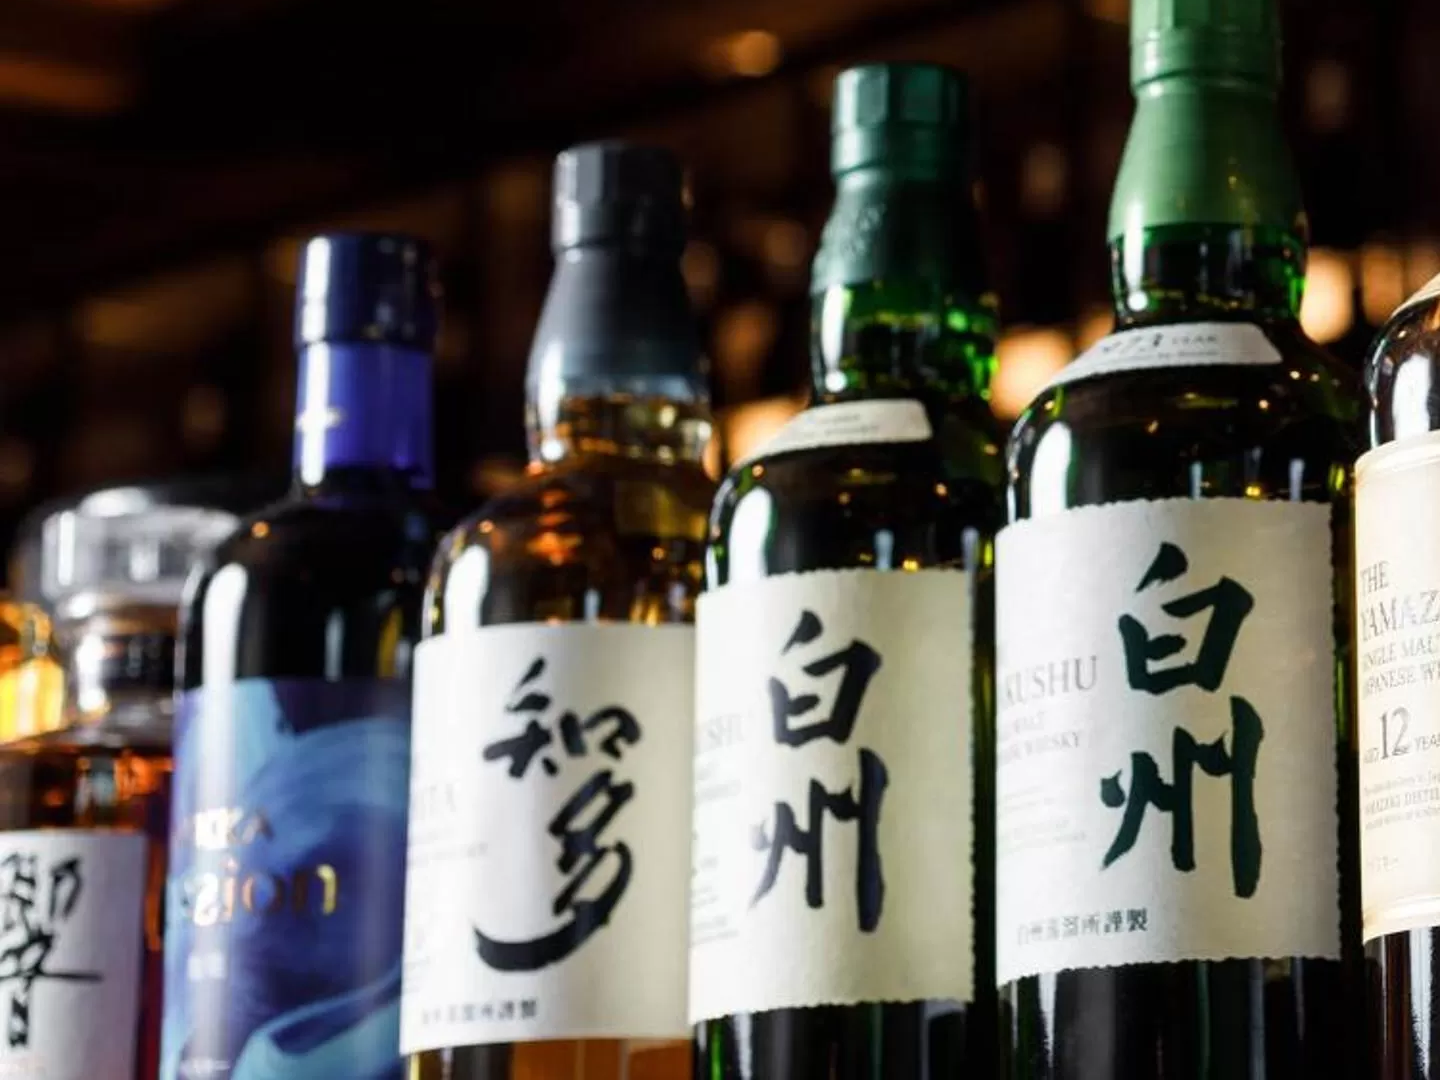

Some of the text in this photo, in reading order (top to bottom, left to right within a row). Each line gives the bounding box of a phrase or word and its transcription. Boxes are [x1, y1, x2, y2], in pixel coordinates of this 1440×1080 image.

[750, 610, 889, 934] 白州
[1100, 542, 1264, 900] 白州
[1380, 706, 1411, 760] 12
